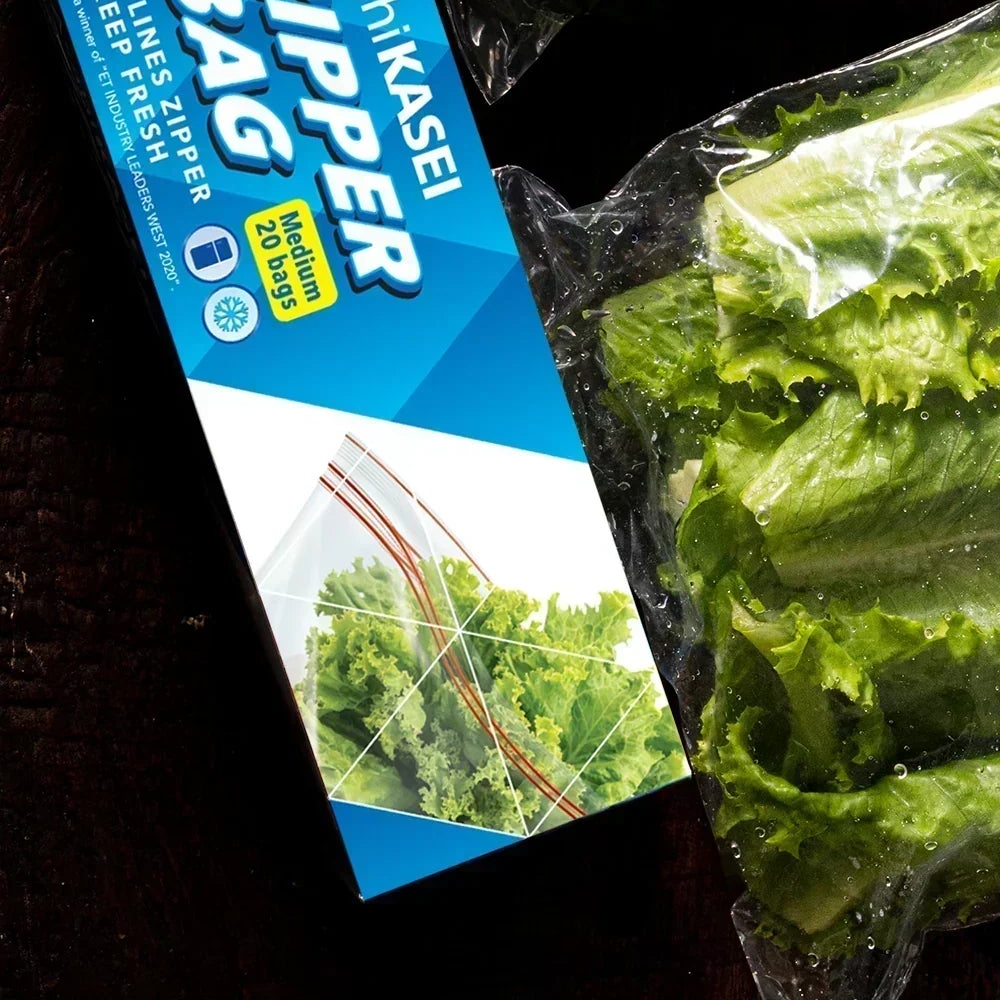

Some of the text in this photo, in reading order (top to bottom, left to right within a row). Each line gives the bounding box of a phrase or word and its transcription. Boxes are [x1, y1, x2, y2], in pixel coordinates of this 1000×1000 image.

[76, 7, 97, 47] winner
[91, 50, 105, 63] of
[104, 90, 135, 152] INDUSTRY
[126, 154, 155, 212] LEADERS
[146, 212, 168, 247] WEST
[121, 67, 169, 163] FRESH
[127, 0, 172, 86] LINES
[160, 96, 211, 204] ZIPPER
[255, 219, 297, 309] 20 bags
[279, 210, 321, 303] Medium
